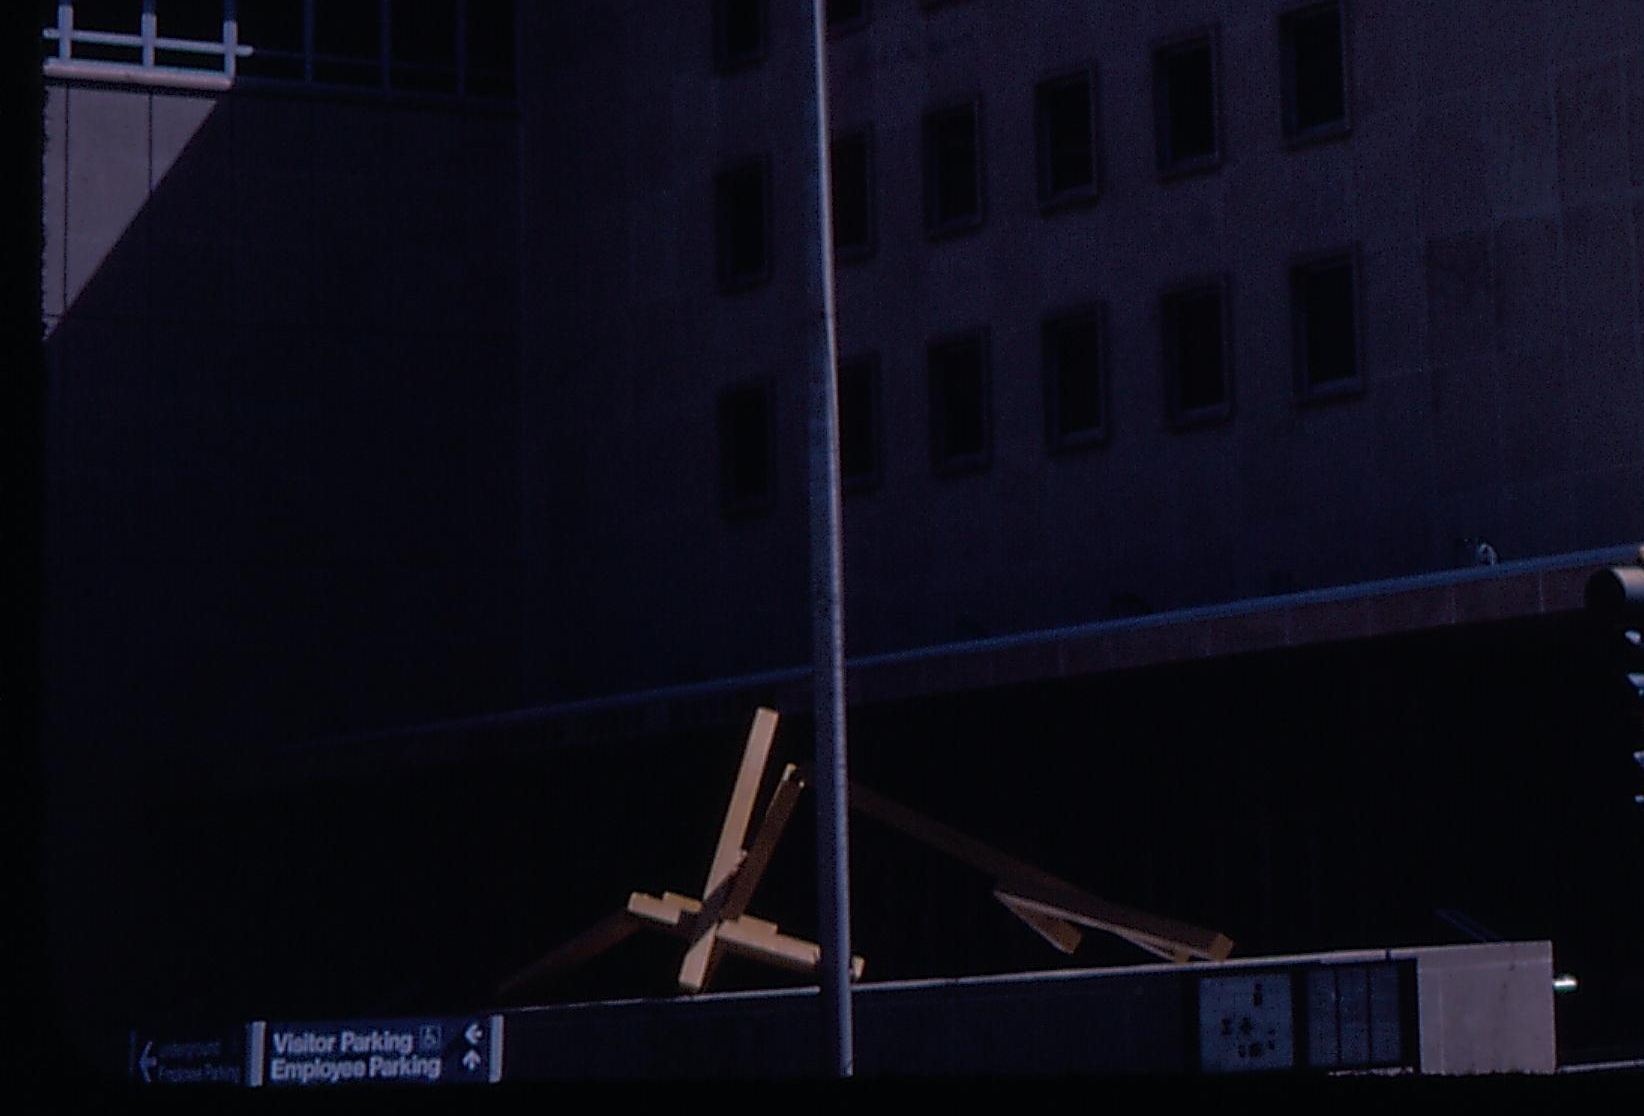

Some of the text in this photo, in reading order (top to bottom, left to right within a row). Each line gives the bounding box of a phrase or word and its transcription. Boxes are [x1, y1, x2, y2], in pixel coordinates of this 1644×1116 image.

[273, 1030, 413, 1056] Visitor Parking
[271, 1055, 442, 1083] Employee Parking
